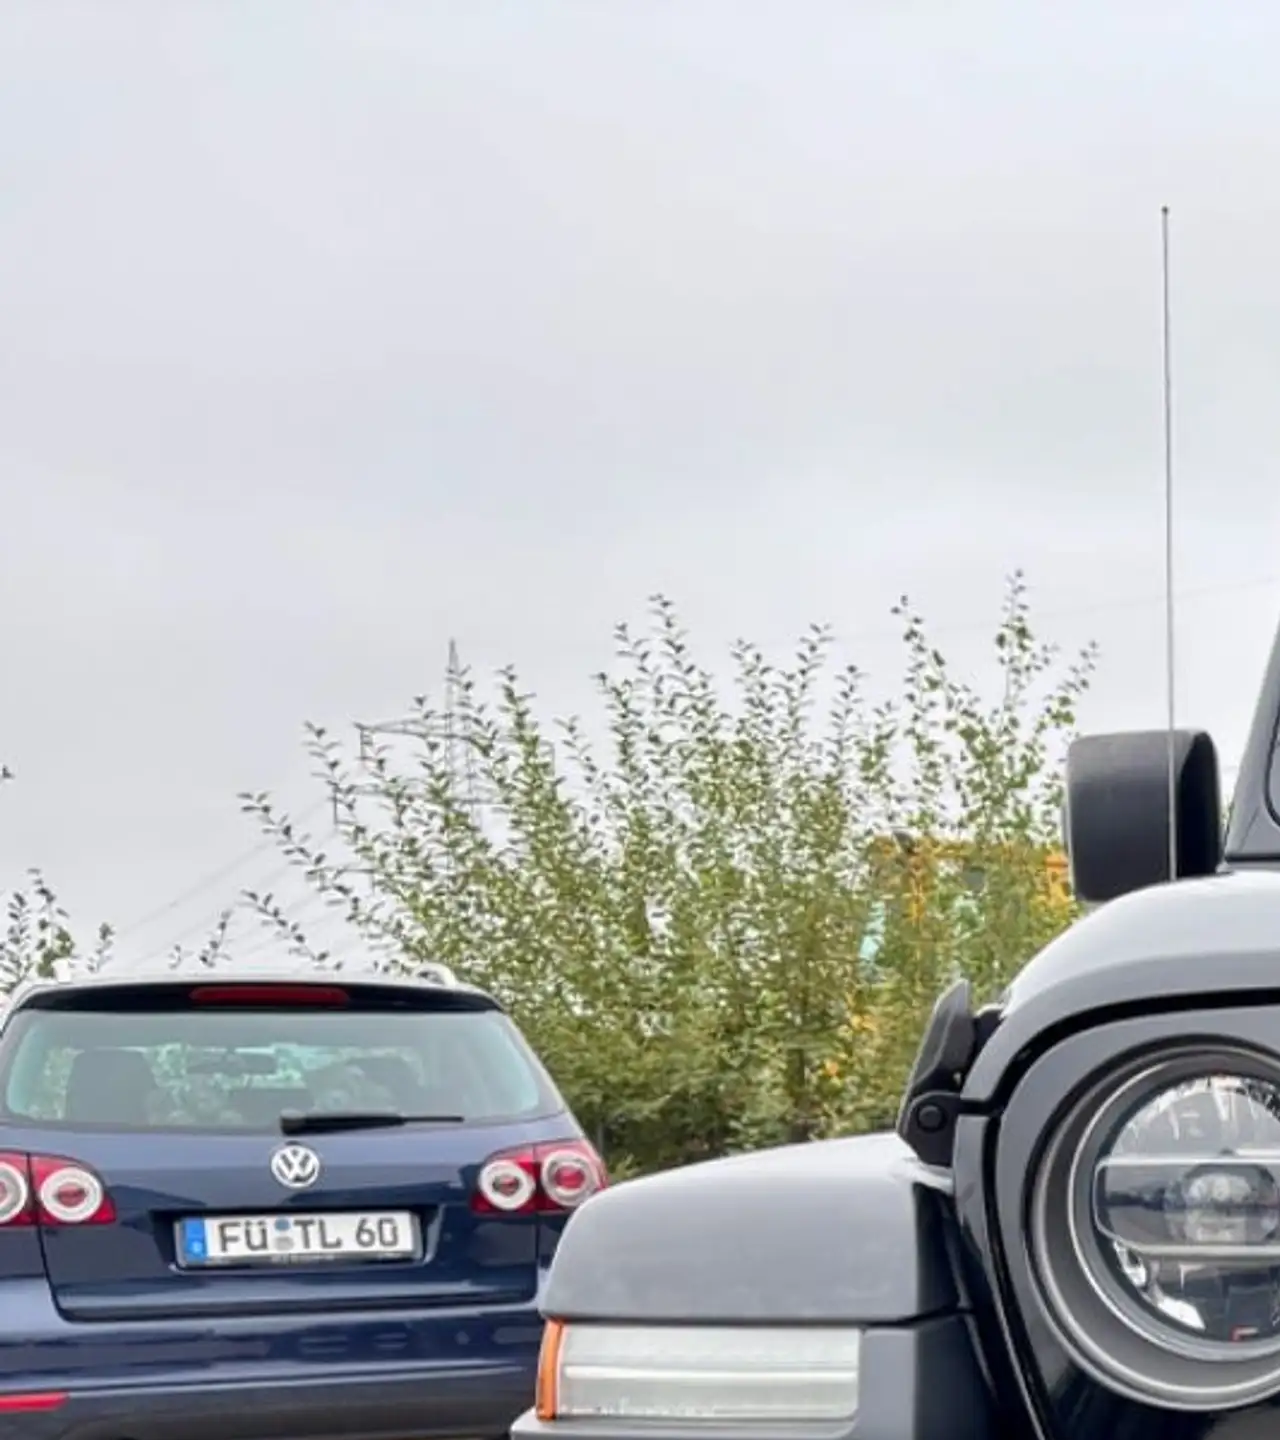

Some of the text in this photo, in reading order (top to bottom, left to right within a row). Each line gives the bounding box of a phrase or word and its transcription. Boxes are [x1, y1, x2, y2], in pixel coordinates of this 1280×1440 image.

[218, 1217, 399, 1254] FÜ TL 60
